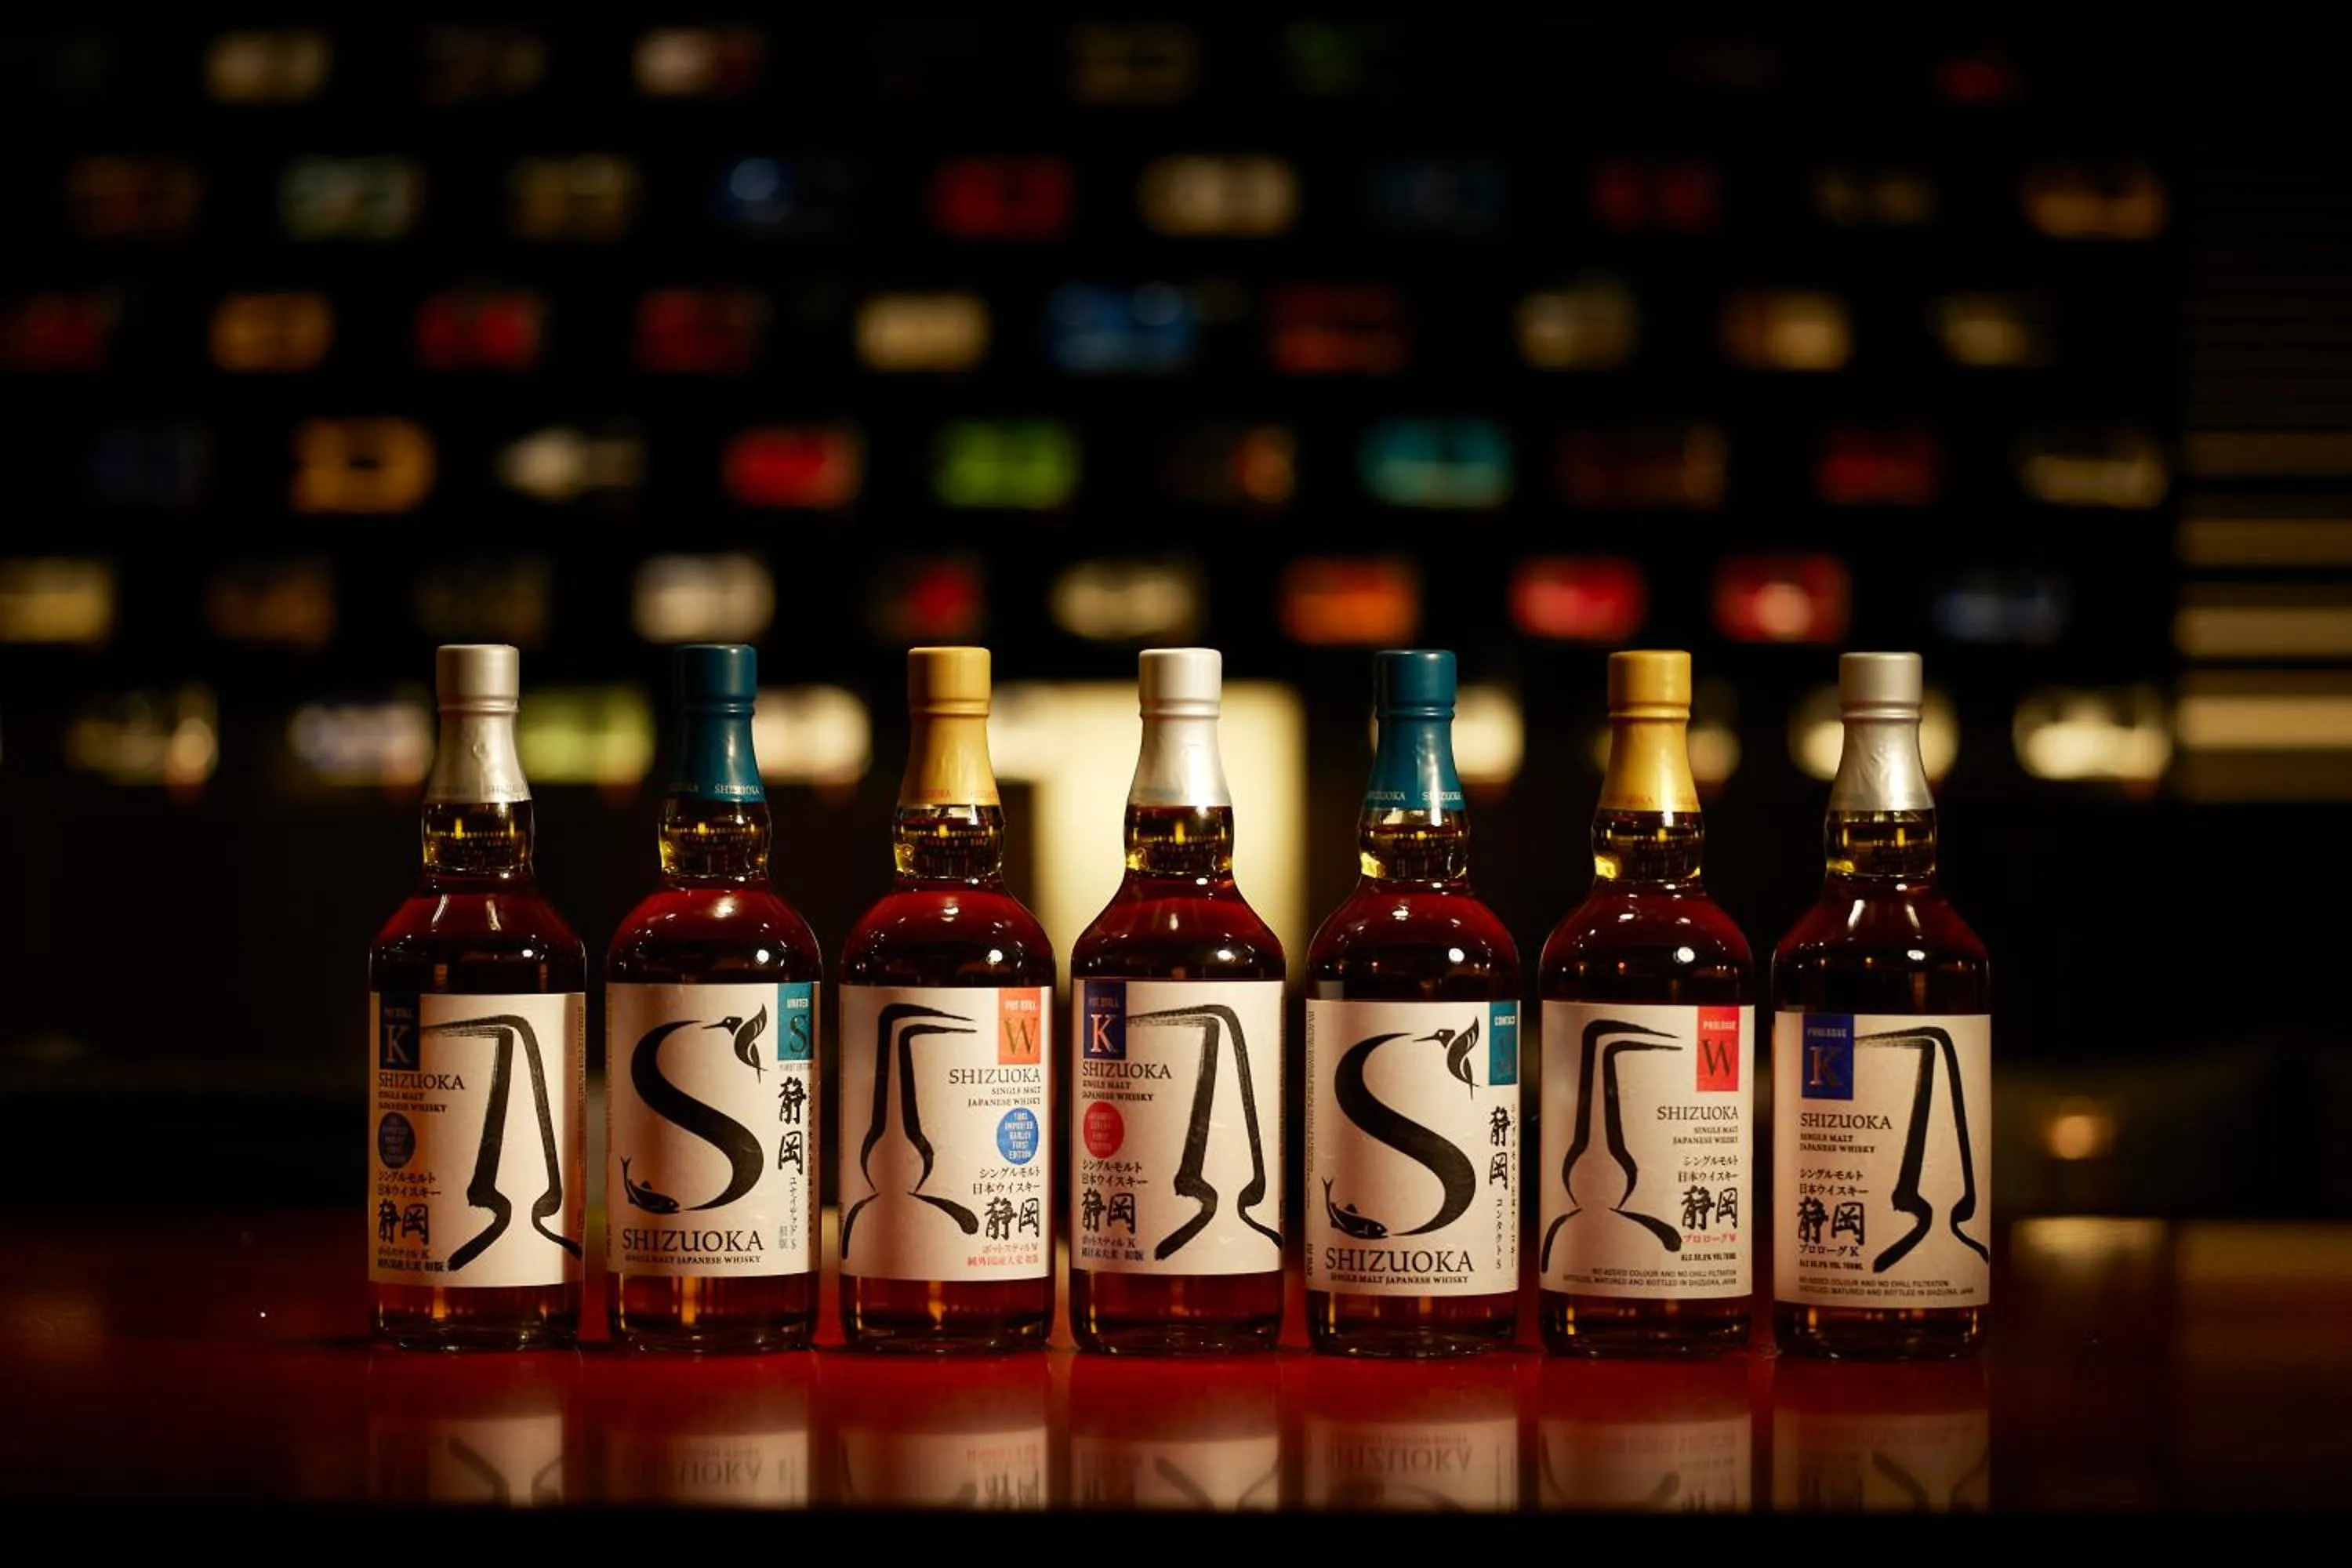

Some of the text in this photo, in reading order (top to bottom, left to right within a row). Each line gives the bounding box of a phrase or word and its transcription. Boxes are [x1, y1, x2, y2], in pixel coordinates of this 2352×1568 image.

[789, 1014, 808, 1054] S
[1004, 1018, 1038, 1054] W
[1091, 1014, 1118, 1053] K
[384, 1024, 411, 1063] K
[1700, 1039, 1734, 1076] W
[1809, 1046, 1842, 1087] K
[949, 1069, 1040, 1084] SHIZUOKA
[1082, 1061, 1172, 1080] SHIZUOKA
[379, 1072, 466, 1091] SHIZUOKA
[967, 1098, 1011, 1107] JAPANESE
[1657, 1105, 1739, 1120] SHIZUOKA
[1800, 1112, 1892, 1130] SHIZUOKA
[778, 1076, 807, 1176] 静岡
[1489, 1106, 1510, 1190] 静岡
[1082, 1159, 1142, 1172] シングルモルト
[1684, 1155, 1738, 1167] シングルモルト
[979, 1166, 1040, 1179] シングルモルト
[1082, 1176, 1148, 1187] 日本ウイスキー
[1678, 1171, 1739, 1183] 日本ウイスキー
[1800, 1168, 1864, 1181] シングルモルト
[973, 1182, 1040, 1196] 日本ウイスキー
[1799, 1183, 1870, 1196] 日本ウイスキー
[1082, 1187, 1135, 1234] 静岡
[1681, 1185, 1738, 1230] 静岡
[378, 1198, 430, 1246] 静岡
[985, 1196, 1040, 1241] 静岡
[1797, 1196, 1865, 1246] 静岡
[622, 1229, 765, 1253] SHIZUOKA
[677, 1256, 722, 1265] JAPANESE
[1325, 1247, 1475, 1273] SHIZUOKA
[1359, 1275, 1383, 1283] MALT
[1385, 1275, 1431, 1285] JAPANESE
[1434, 1275, 1468, 1284] WHISKY
